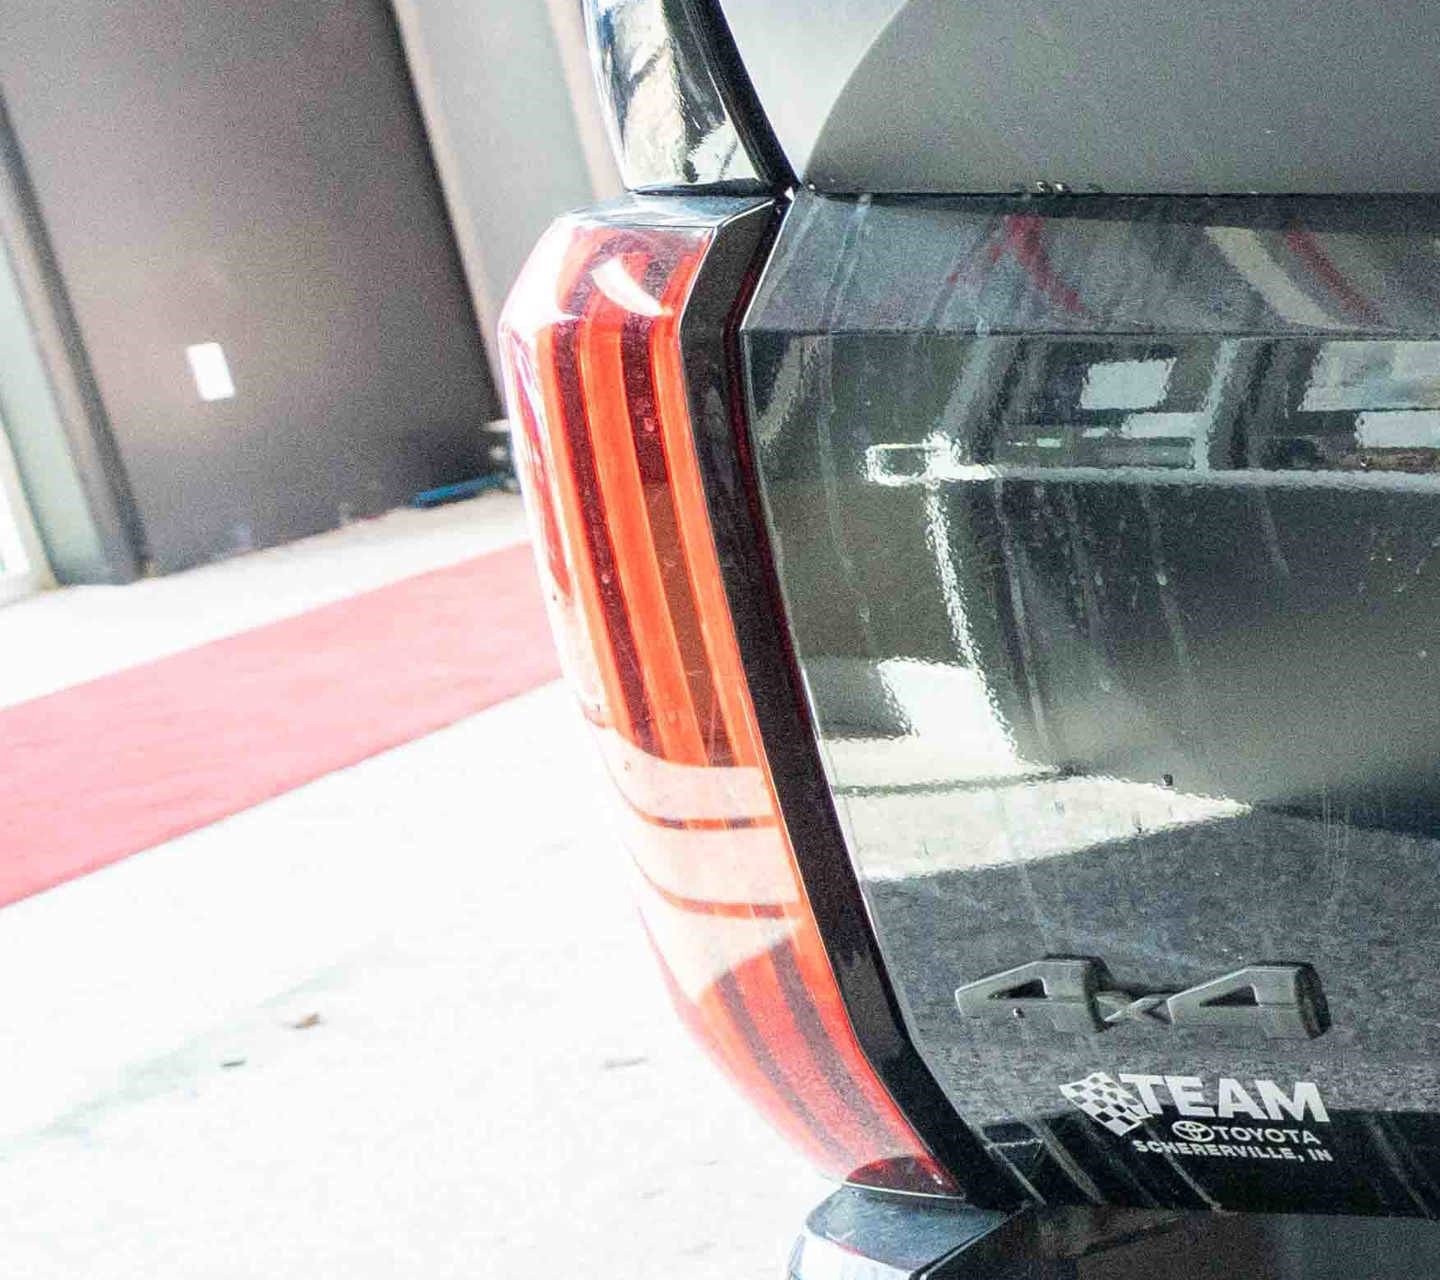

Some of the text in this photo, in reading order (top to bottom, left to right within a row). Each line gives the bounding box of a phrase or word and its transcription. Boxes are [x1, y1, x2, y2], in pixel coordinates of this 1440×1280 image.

[1118, 1073, 1331, 1123] TEAM
[1212, 1126, 1322, 1146] TOYOTA
[1132, 1139, 1334, 1163] SCHERERVILLE, IN
